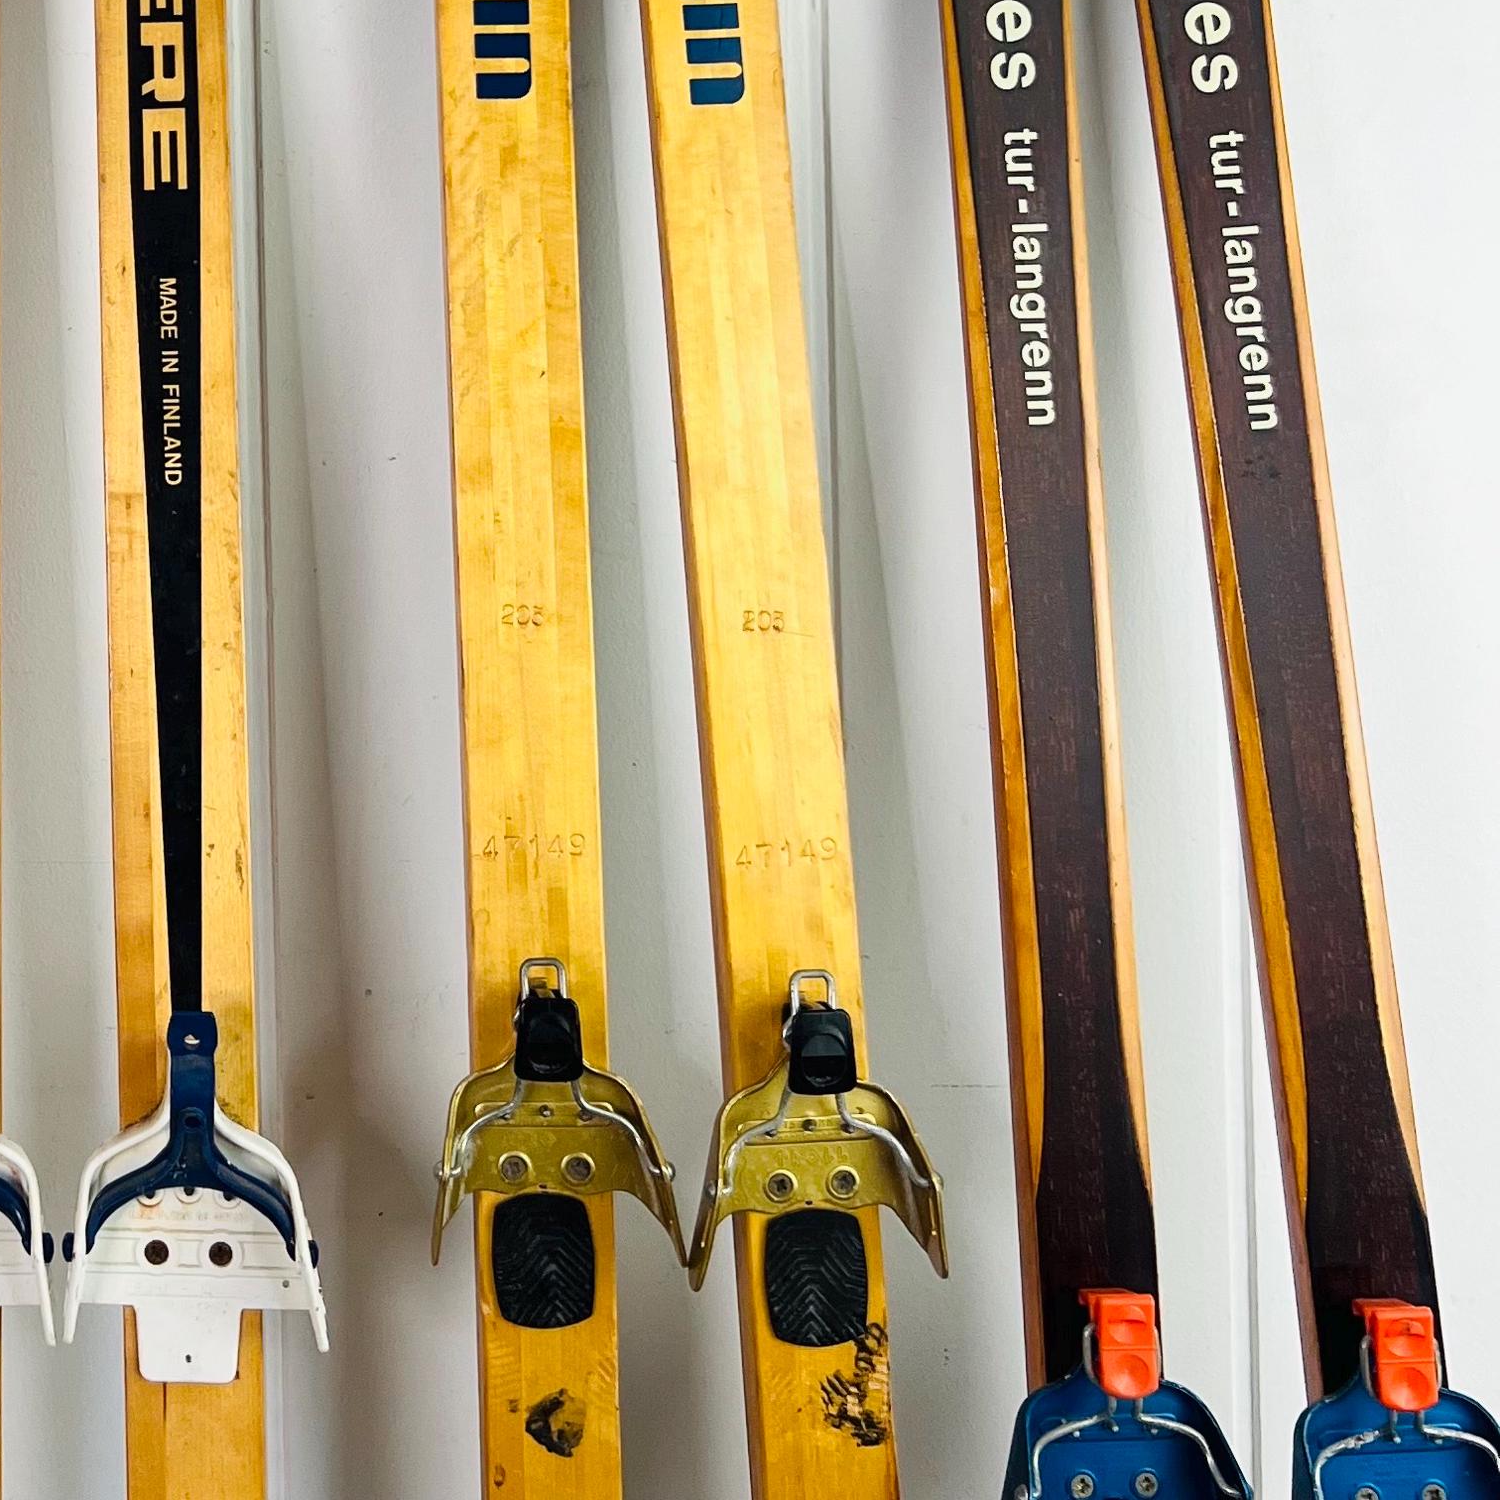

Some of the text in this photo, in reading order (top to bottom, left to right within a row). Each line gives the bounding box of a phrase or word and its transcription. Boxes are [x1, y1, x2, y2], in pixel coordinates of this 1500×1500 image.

[159, 277, 182, 486] MADE IN FINLAND
[1003, 127, 1056, 427] tur-langrenn
[1208, 130, 1279, 432] tur-langrenn
